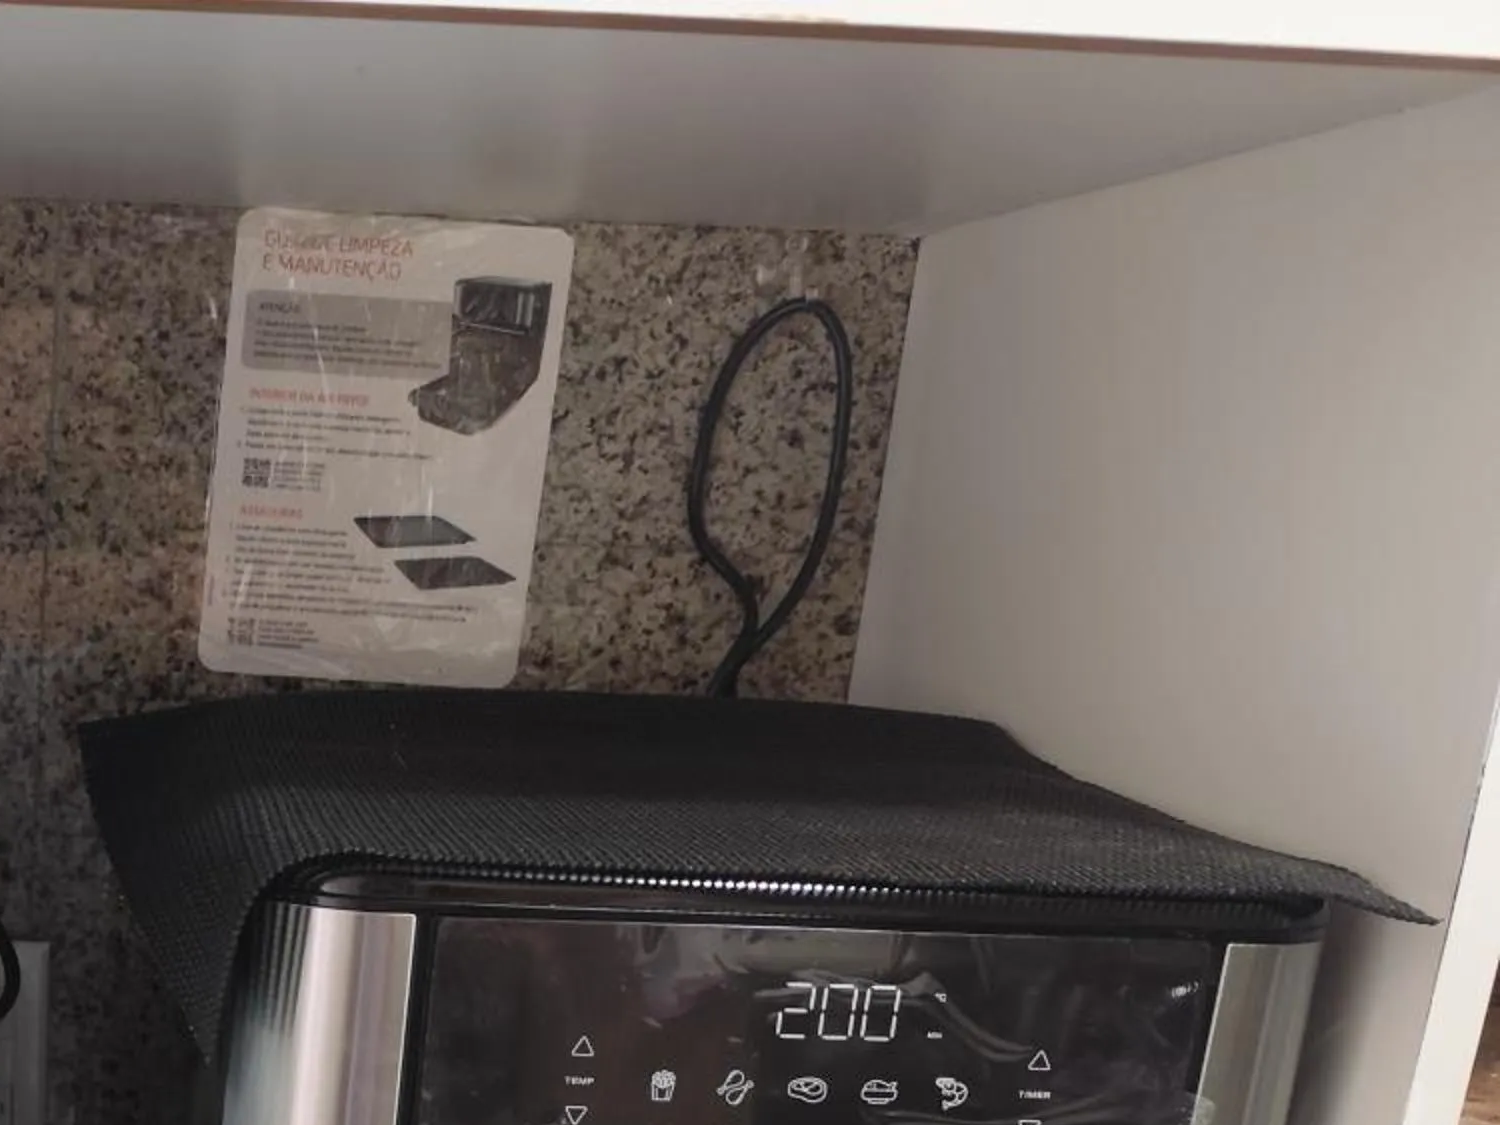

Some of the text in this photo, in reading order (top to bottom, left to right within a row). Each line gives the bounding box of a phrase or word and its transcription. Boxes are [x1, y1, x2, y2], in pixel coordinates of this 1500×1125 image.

[339, 235, 414, 257] LIMPEZA
[262, 253, 402, 282] E MANUTENÇÃO
[776, 981, 902, 1042] 200
[564, 1075, 595, 1085] TEMP
[1019, 1090, 1051, 1099] TIMER
